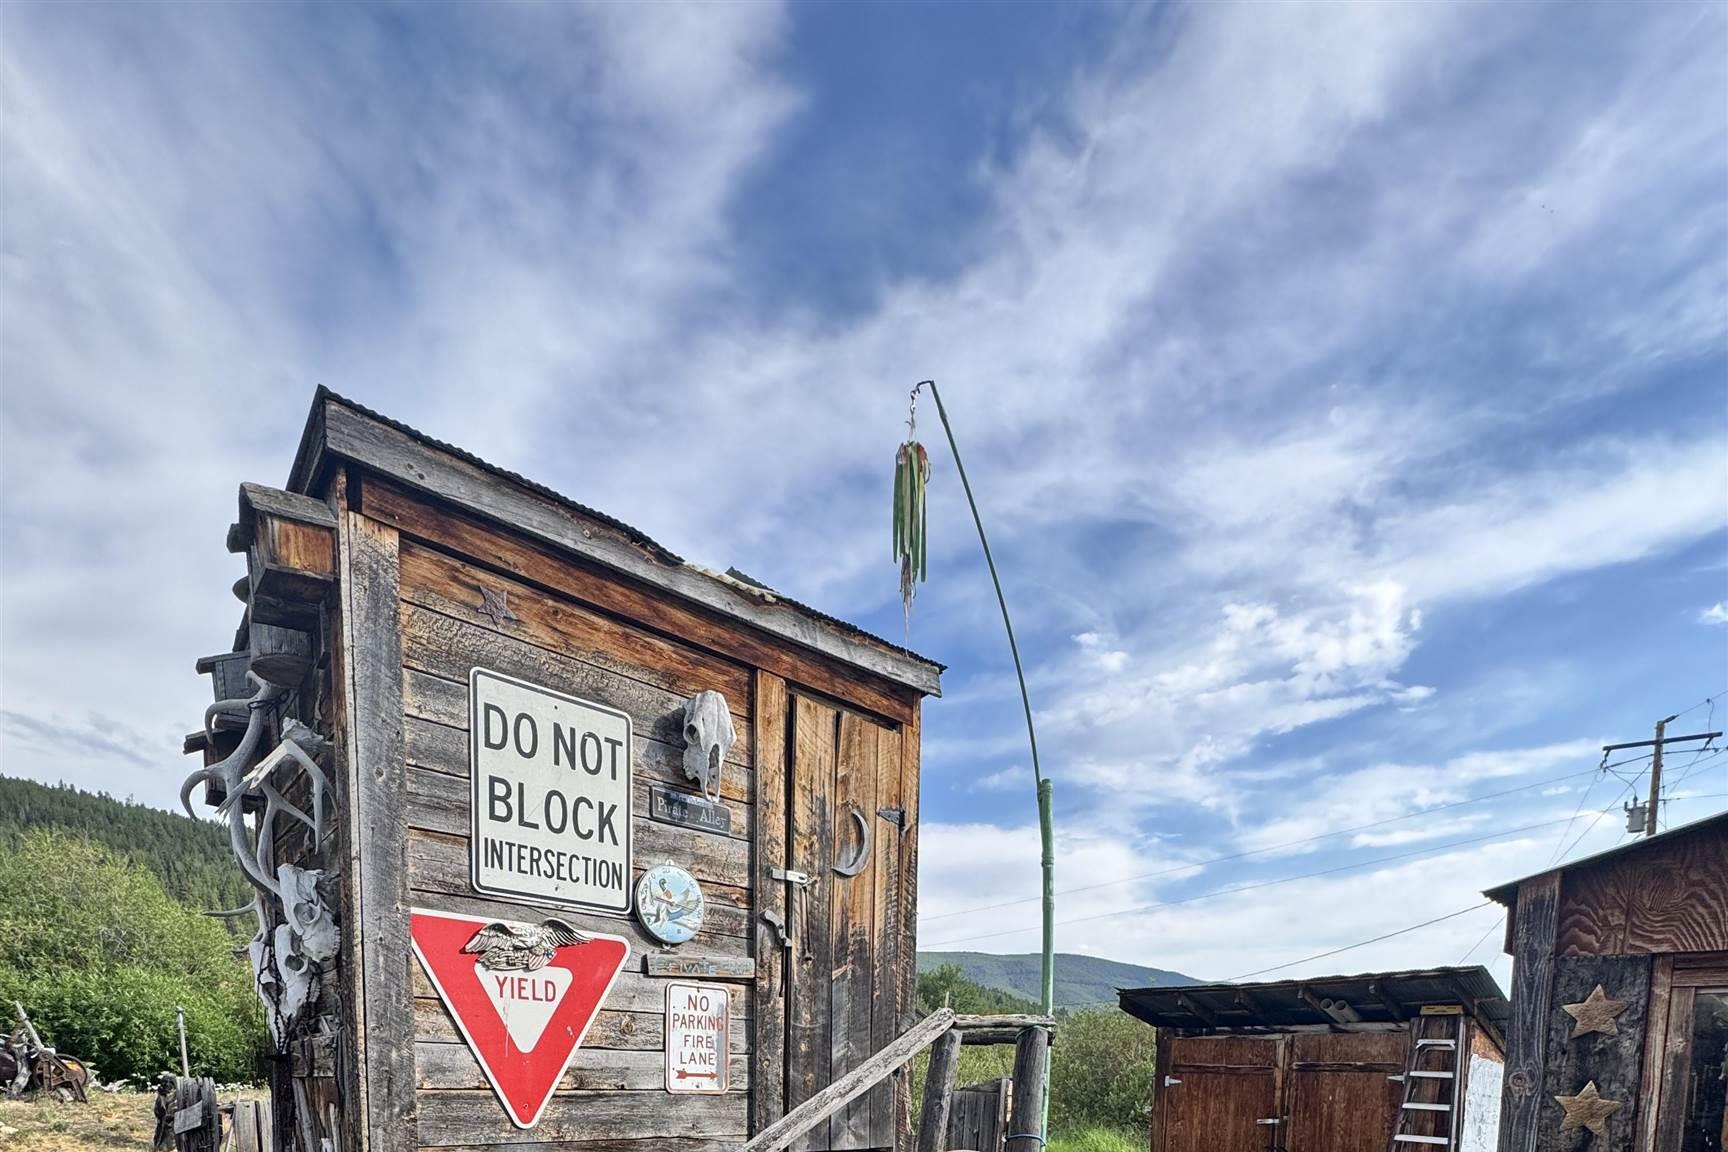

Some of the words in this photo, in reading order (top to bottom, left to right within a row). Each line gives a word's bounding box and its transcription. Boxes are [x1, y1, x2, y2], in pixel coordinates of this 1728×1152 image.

[484, 702, 538, 759] DO
[553, 722, 624, 781] NOT
[488, 775, 619, 846] BLOCK
[656, 796, 688, 818] Pirate
[700, 808, 727, 829] Alley
[484, 837, 623, 891] INTERSECTION
[495, 975, 556, 1002] YIELD
[687, 994, 710, 1012] NO
[672, 1013, 724, 1032] PARKING
[683, 1034, 713, 1048] FIRE
[680, 1051, 716, 1066] LANE
